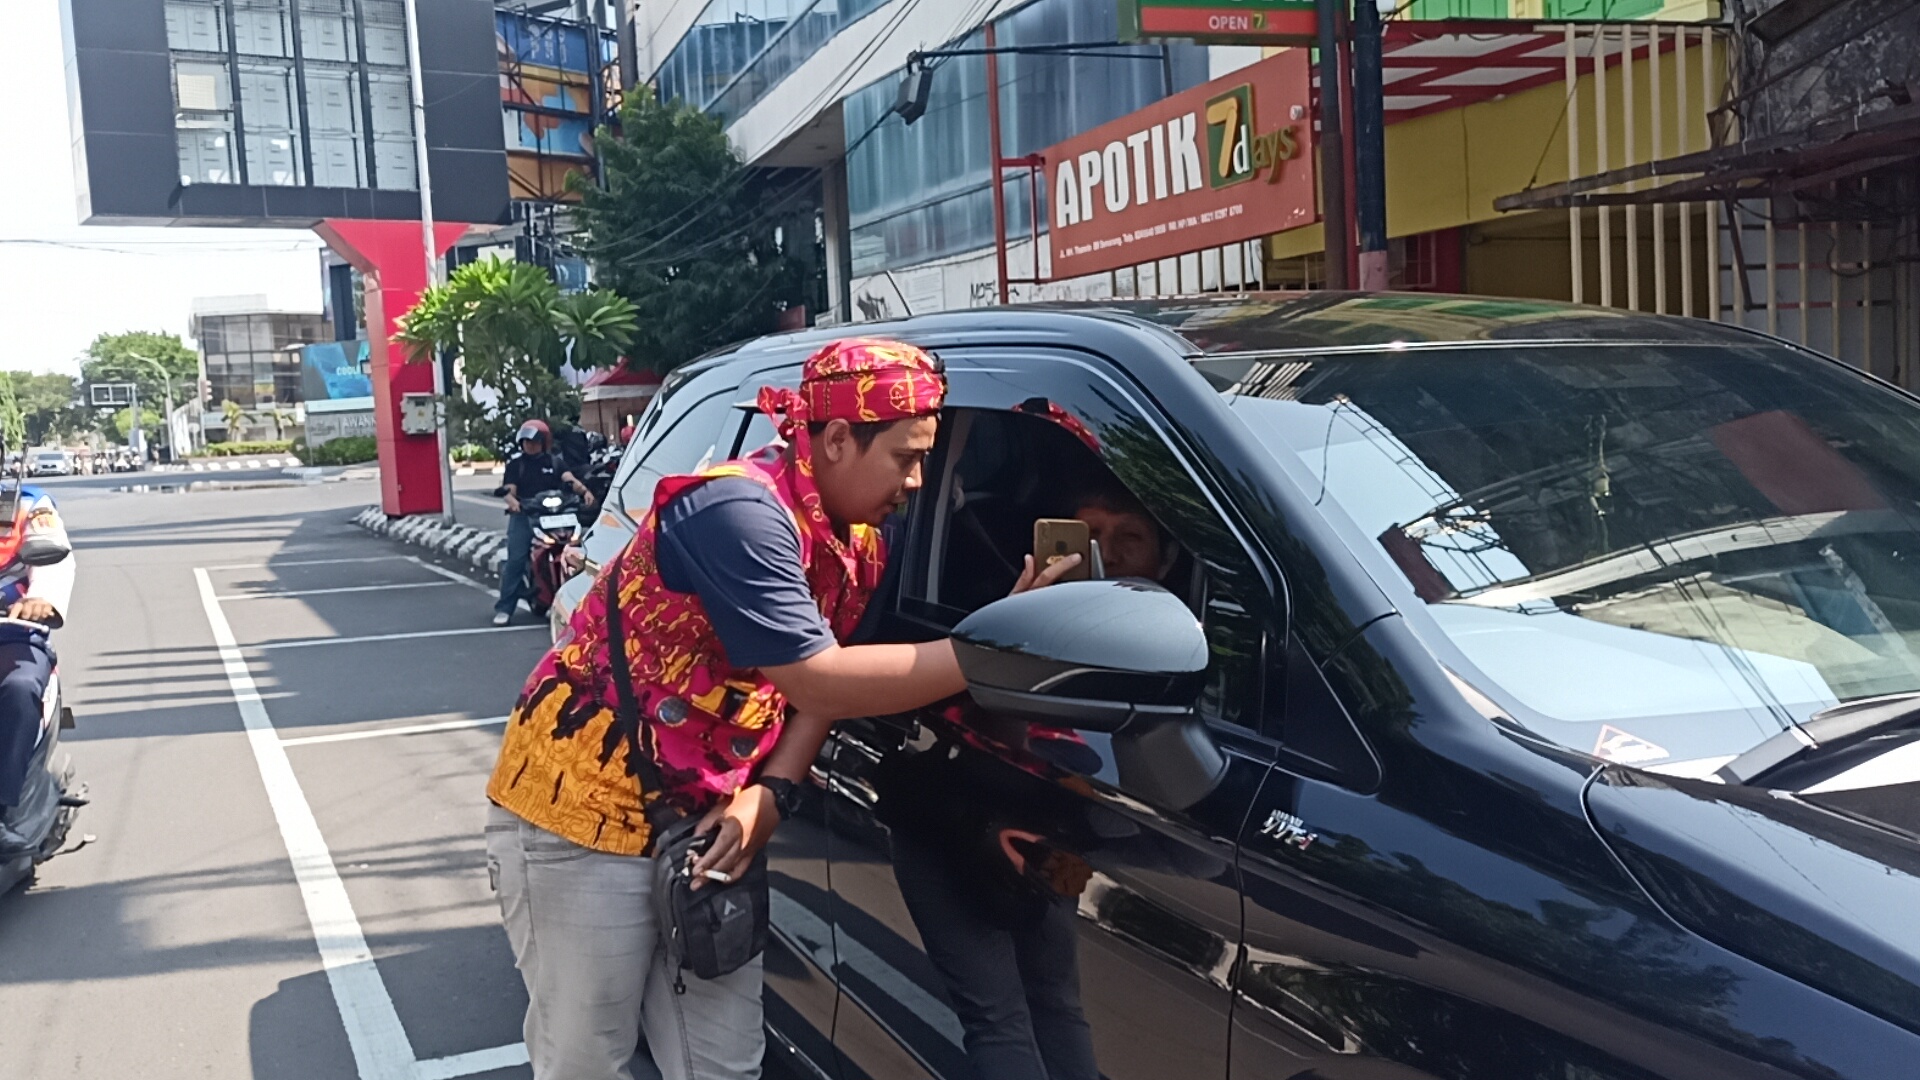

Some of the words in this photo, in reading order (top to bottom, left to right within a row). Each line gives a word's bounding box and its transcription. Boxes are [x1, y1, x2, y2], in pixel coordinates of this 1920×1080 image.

[1208, 15, 1248, 30] OPEN
[1253, 13, 1264, 29] 7
[1055, 111, 1204, 229] APOTIK
